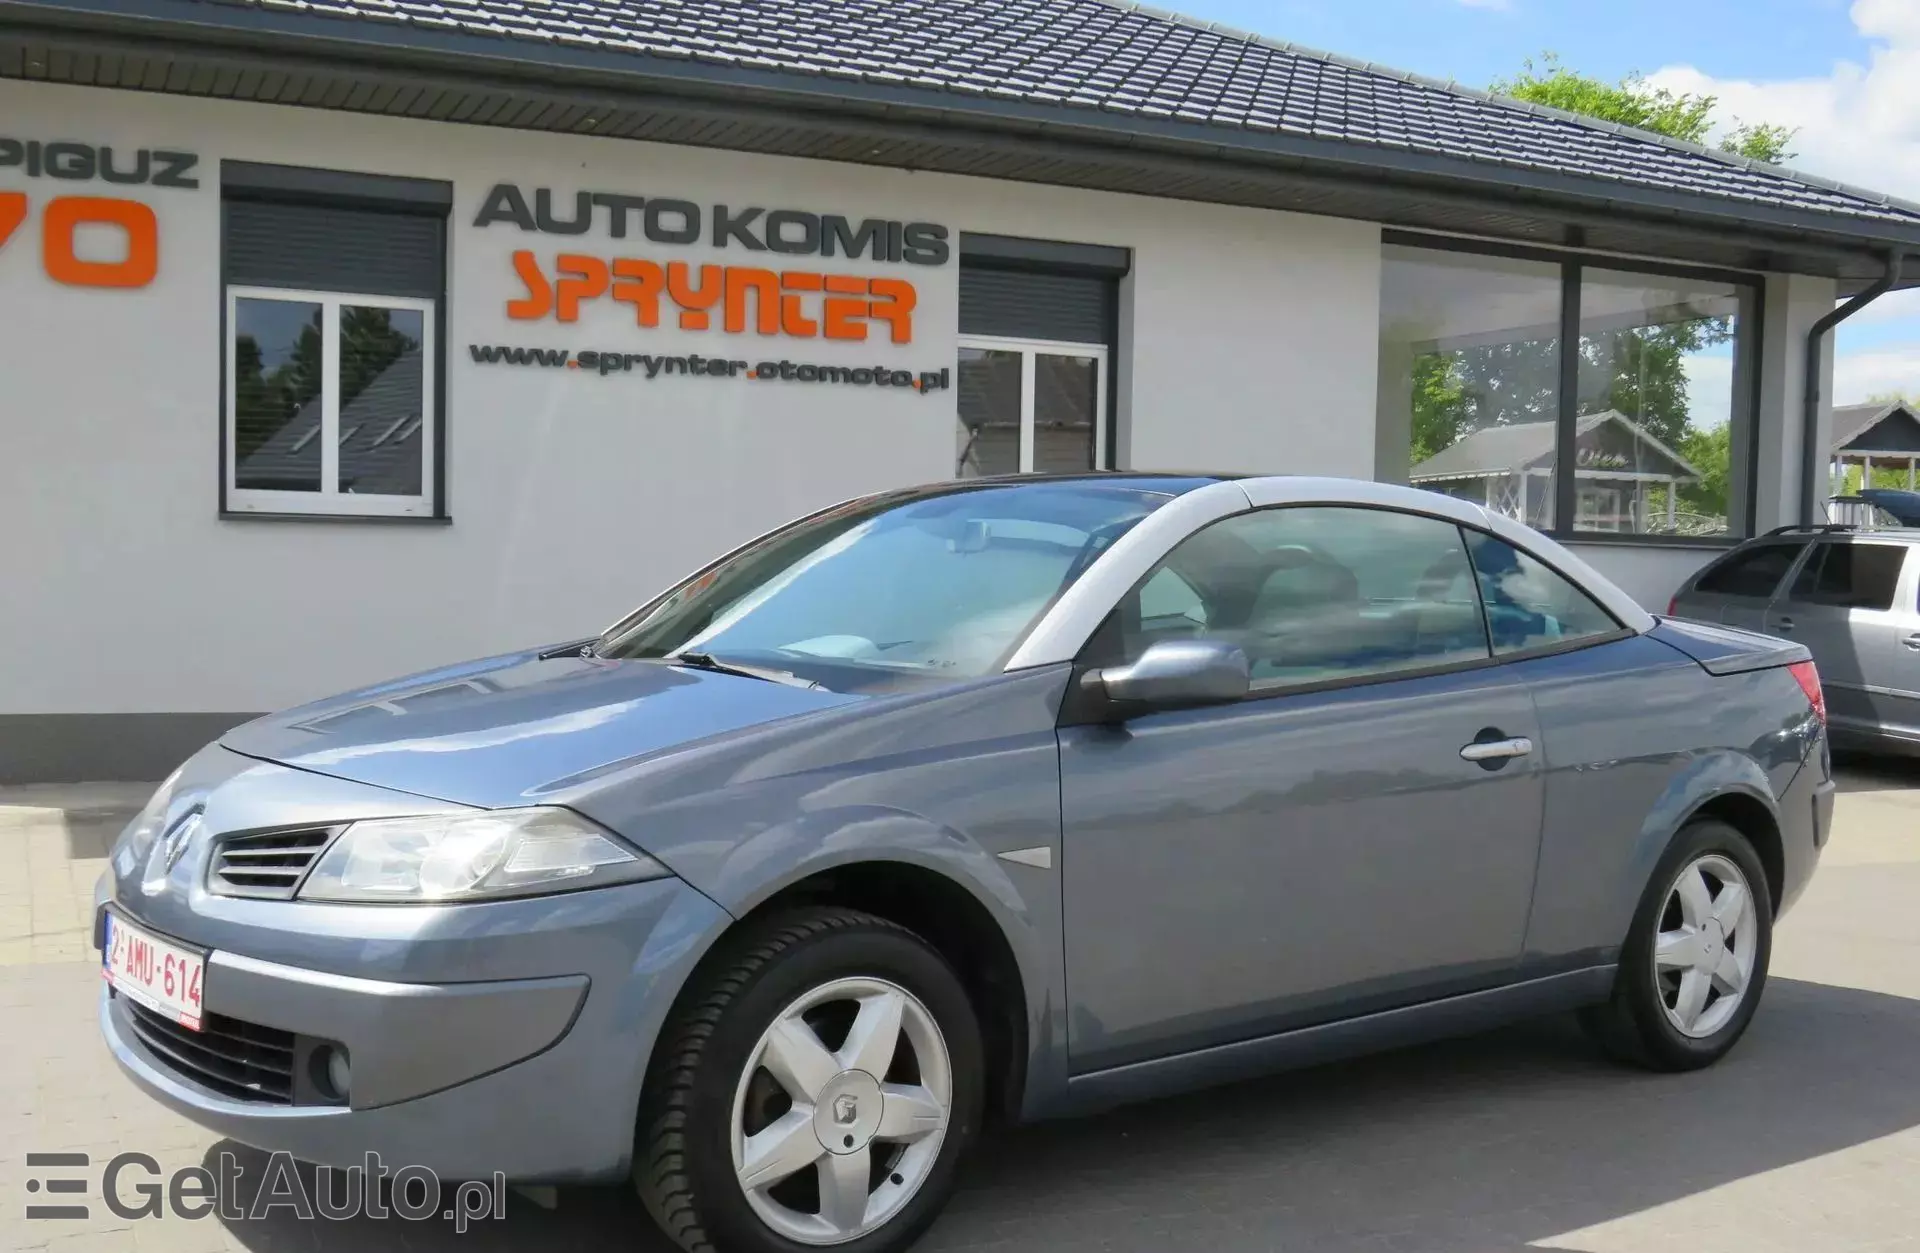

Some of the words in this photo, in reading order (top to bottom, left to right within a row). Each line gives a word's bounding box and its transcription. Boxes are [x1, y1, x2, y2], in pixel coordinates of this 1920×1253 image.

[472, 183, 701, 245] AUTO
[712, 204, 950, 265] KOMIS
[506, 250, 918, 344] SPRYNTER
[469, 343, 950, 394] www.sprynter.otomoto.pl
